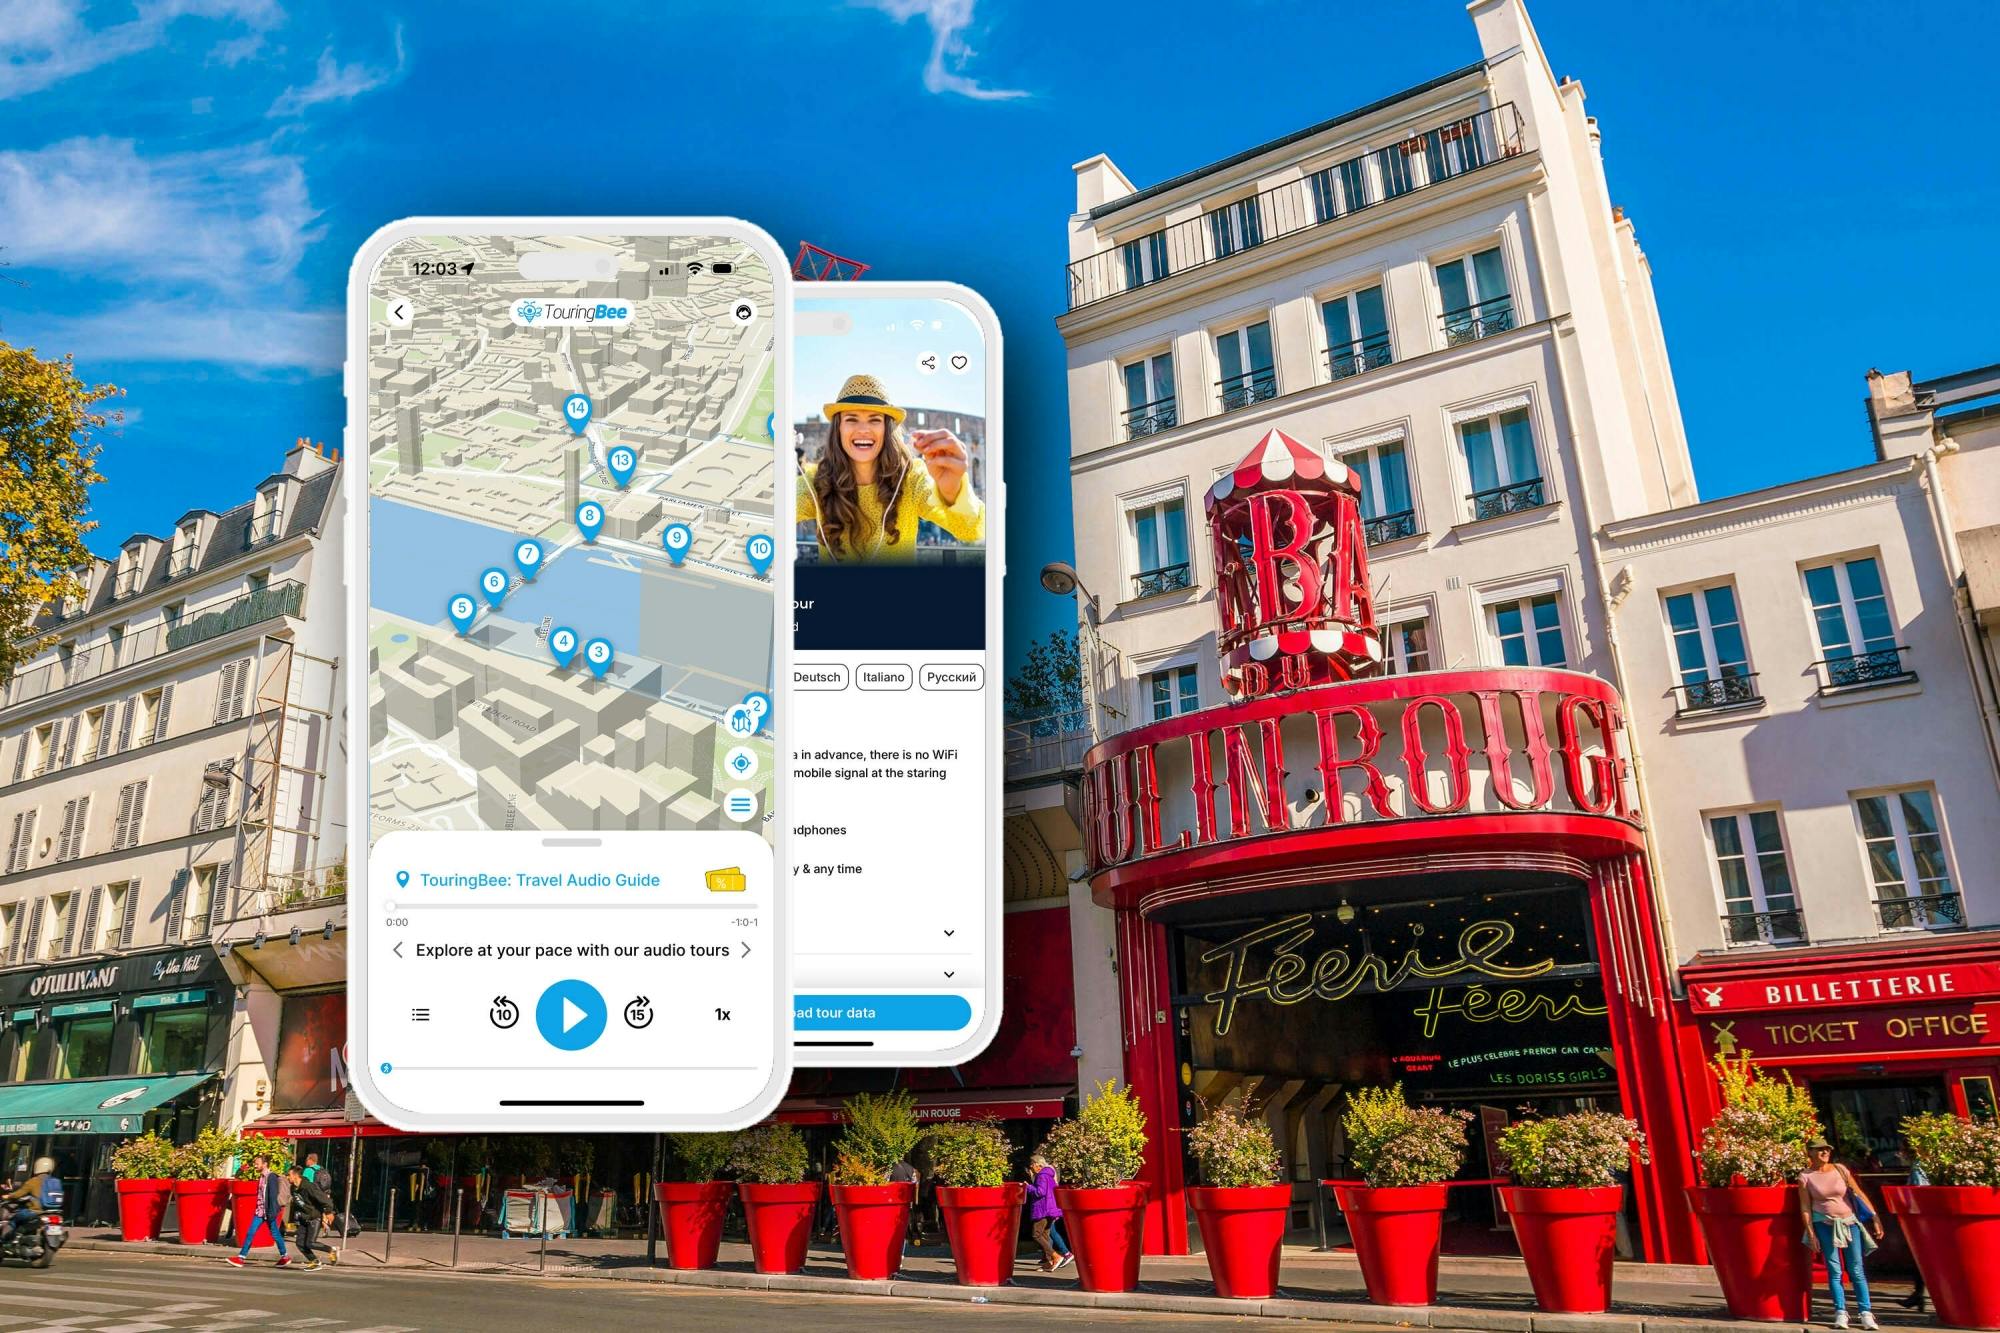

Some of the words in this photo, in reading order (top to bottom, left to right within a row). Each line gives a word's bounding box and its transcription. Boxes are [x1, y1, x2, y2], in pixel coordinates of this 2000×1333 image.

[412, 262, 458, 276] 12:03
[544, 303, 628, 323] TouringBee
[570, 402, 585, 414] 14
[614, 454, 629, 466] 13
[658, 496, 705, 509] PARLIAMEN
[585, 509, 594, 521] 8
[672, 531, 682, 543] 9
[524, 547, 533, 559] 7
[753, 542, 768, 554] 10
[490, 575, 499, 587] 6
[457, 602, 466, 613] 5
[559, 635, 568, 647] 4
[594, 646, 603, 658] 3
[793, 671, 841, 683] Deutsch
[863, 671, 905, 683] Italiano
[927, 671, 977, 685] Русский
[752, 700, 761, 712] 2
[512, 718, 537, 732] ROAD
[801, 748, 812, 761] in
[814, 748, 867, 763] advance,
[869, 748, 899, 761] there
[901, 748, 913, 761] is
[915, 751, 930, 761] no
[932, 748, 958, 761] WiFi
[1309, 690, 1634, 825] ROUG
[793, 767, 831, 779] mobile
[834, 767, 869, 781] signal
[871, 768, 883, 779] at
[885, 767, 904, 779] the
[907, 767, 947, 782] staring
[803, 863, 811, 875] &
[813, 865, 835, 878] any
[836, 863, 863, 875] time
[420, 872, 512, 890] TouringBee:
[516, 872, 563, 887] Travel
[567, 872, 612, 887] Audio
[616, 872, 661, 887] Guide
[385, 917, 409, 927] 0:00
[730, 917, 758, 927] -1:0-1
[415, 942, 474, 960] Explore
[477, 943, 493, 958] at
[496, 945, 531, 960] your
[535, 945, 573, 960] pace
[576, 942, 610, 959] with
[613, 945, 641, 959] our
[643, 942, 687, 959] audio
[690, 943, 731, 959] tours
[1200, 913, 1555, 1036] Féerie
[1765, 972, 1955, 1004] BILLETTERIE
[497, 1009, 512, 1021] 10
[630, 1009, 645, 1021] 15
[714, 1008, 732, 1022] 1x
[815, 1008, 844, 1019] tour
[846, 1007, 876, 1019] data
[1764, 1020, 1859, 1045] TICKET
[1885, 1013, 1990, 1039] OFFICE
[1448, 1057, 1460, 1069] LE
[1461, 1054, 1484, 1066] PLUS
[1483, 1048, 1521, 1061] CELEBRE
[1523, 1046, 1557, 1056] FRENCH
[1561, 1046, 1579, 1055] CAN
[1490, 1072, 1513, 1084] LES
[1517, 1072, 1566, 1084] DORISS
[1569, 1067, 1607, 1083] GIRLS
[930, 1108, 961, 1118] ROUGE
[305, 1128, 323, 1136] ROUGE
